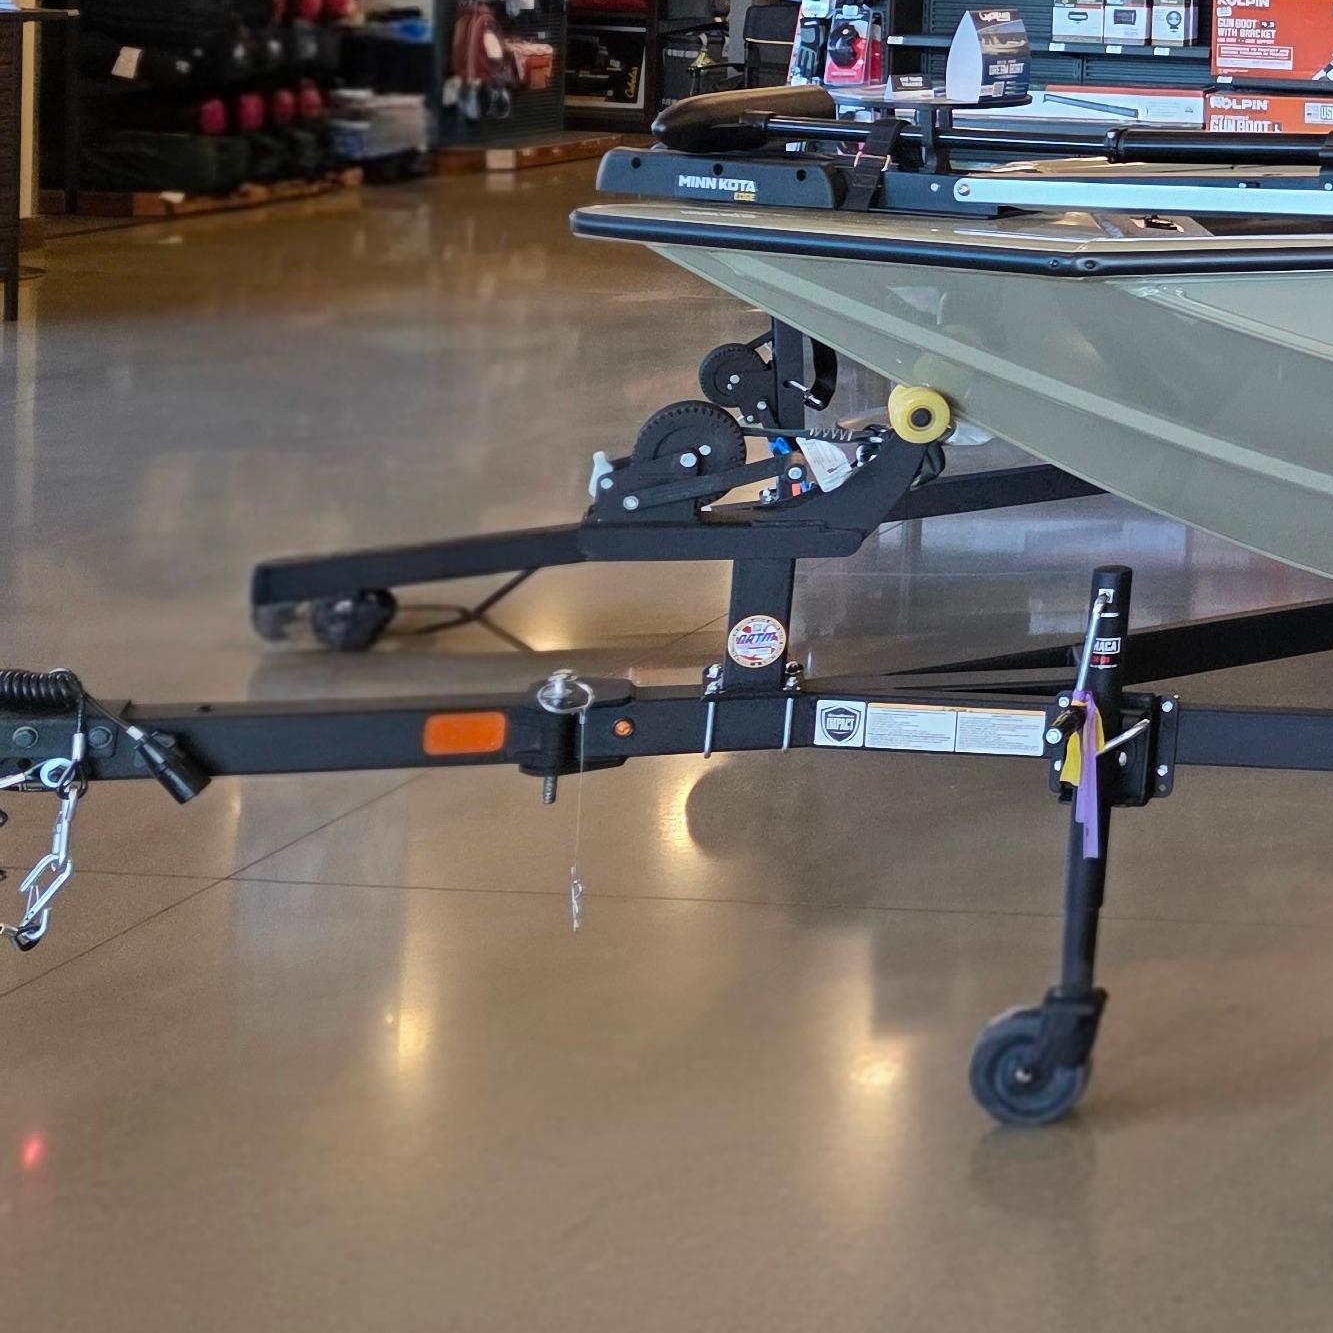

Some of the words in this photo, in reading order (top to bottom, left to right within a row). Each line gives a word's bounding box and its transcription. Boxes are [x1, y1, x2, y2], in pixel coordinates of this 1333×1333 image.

[1217, 18, 1235, 28] GUN
[1235, 19, 1258, 29] BOOT
[1217, 28, 1238, 37] WITH
[1239, 29, 1276, 39] BRACKET
[678, 174, 717, 190] MINN
[718, 177, 756, 192] KOTA
